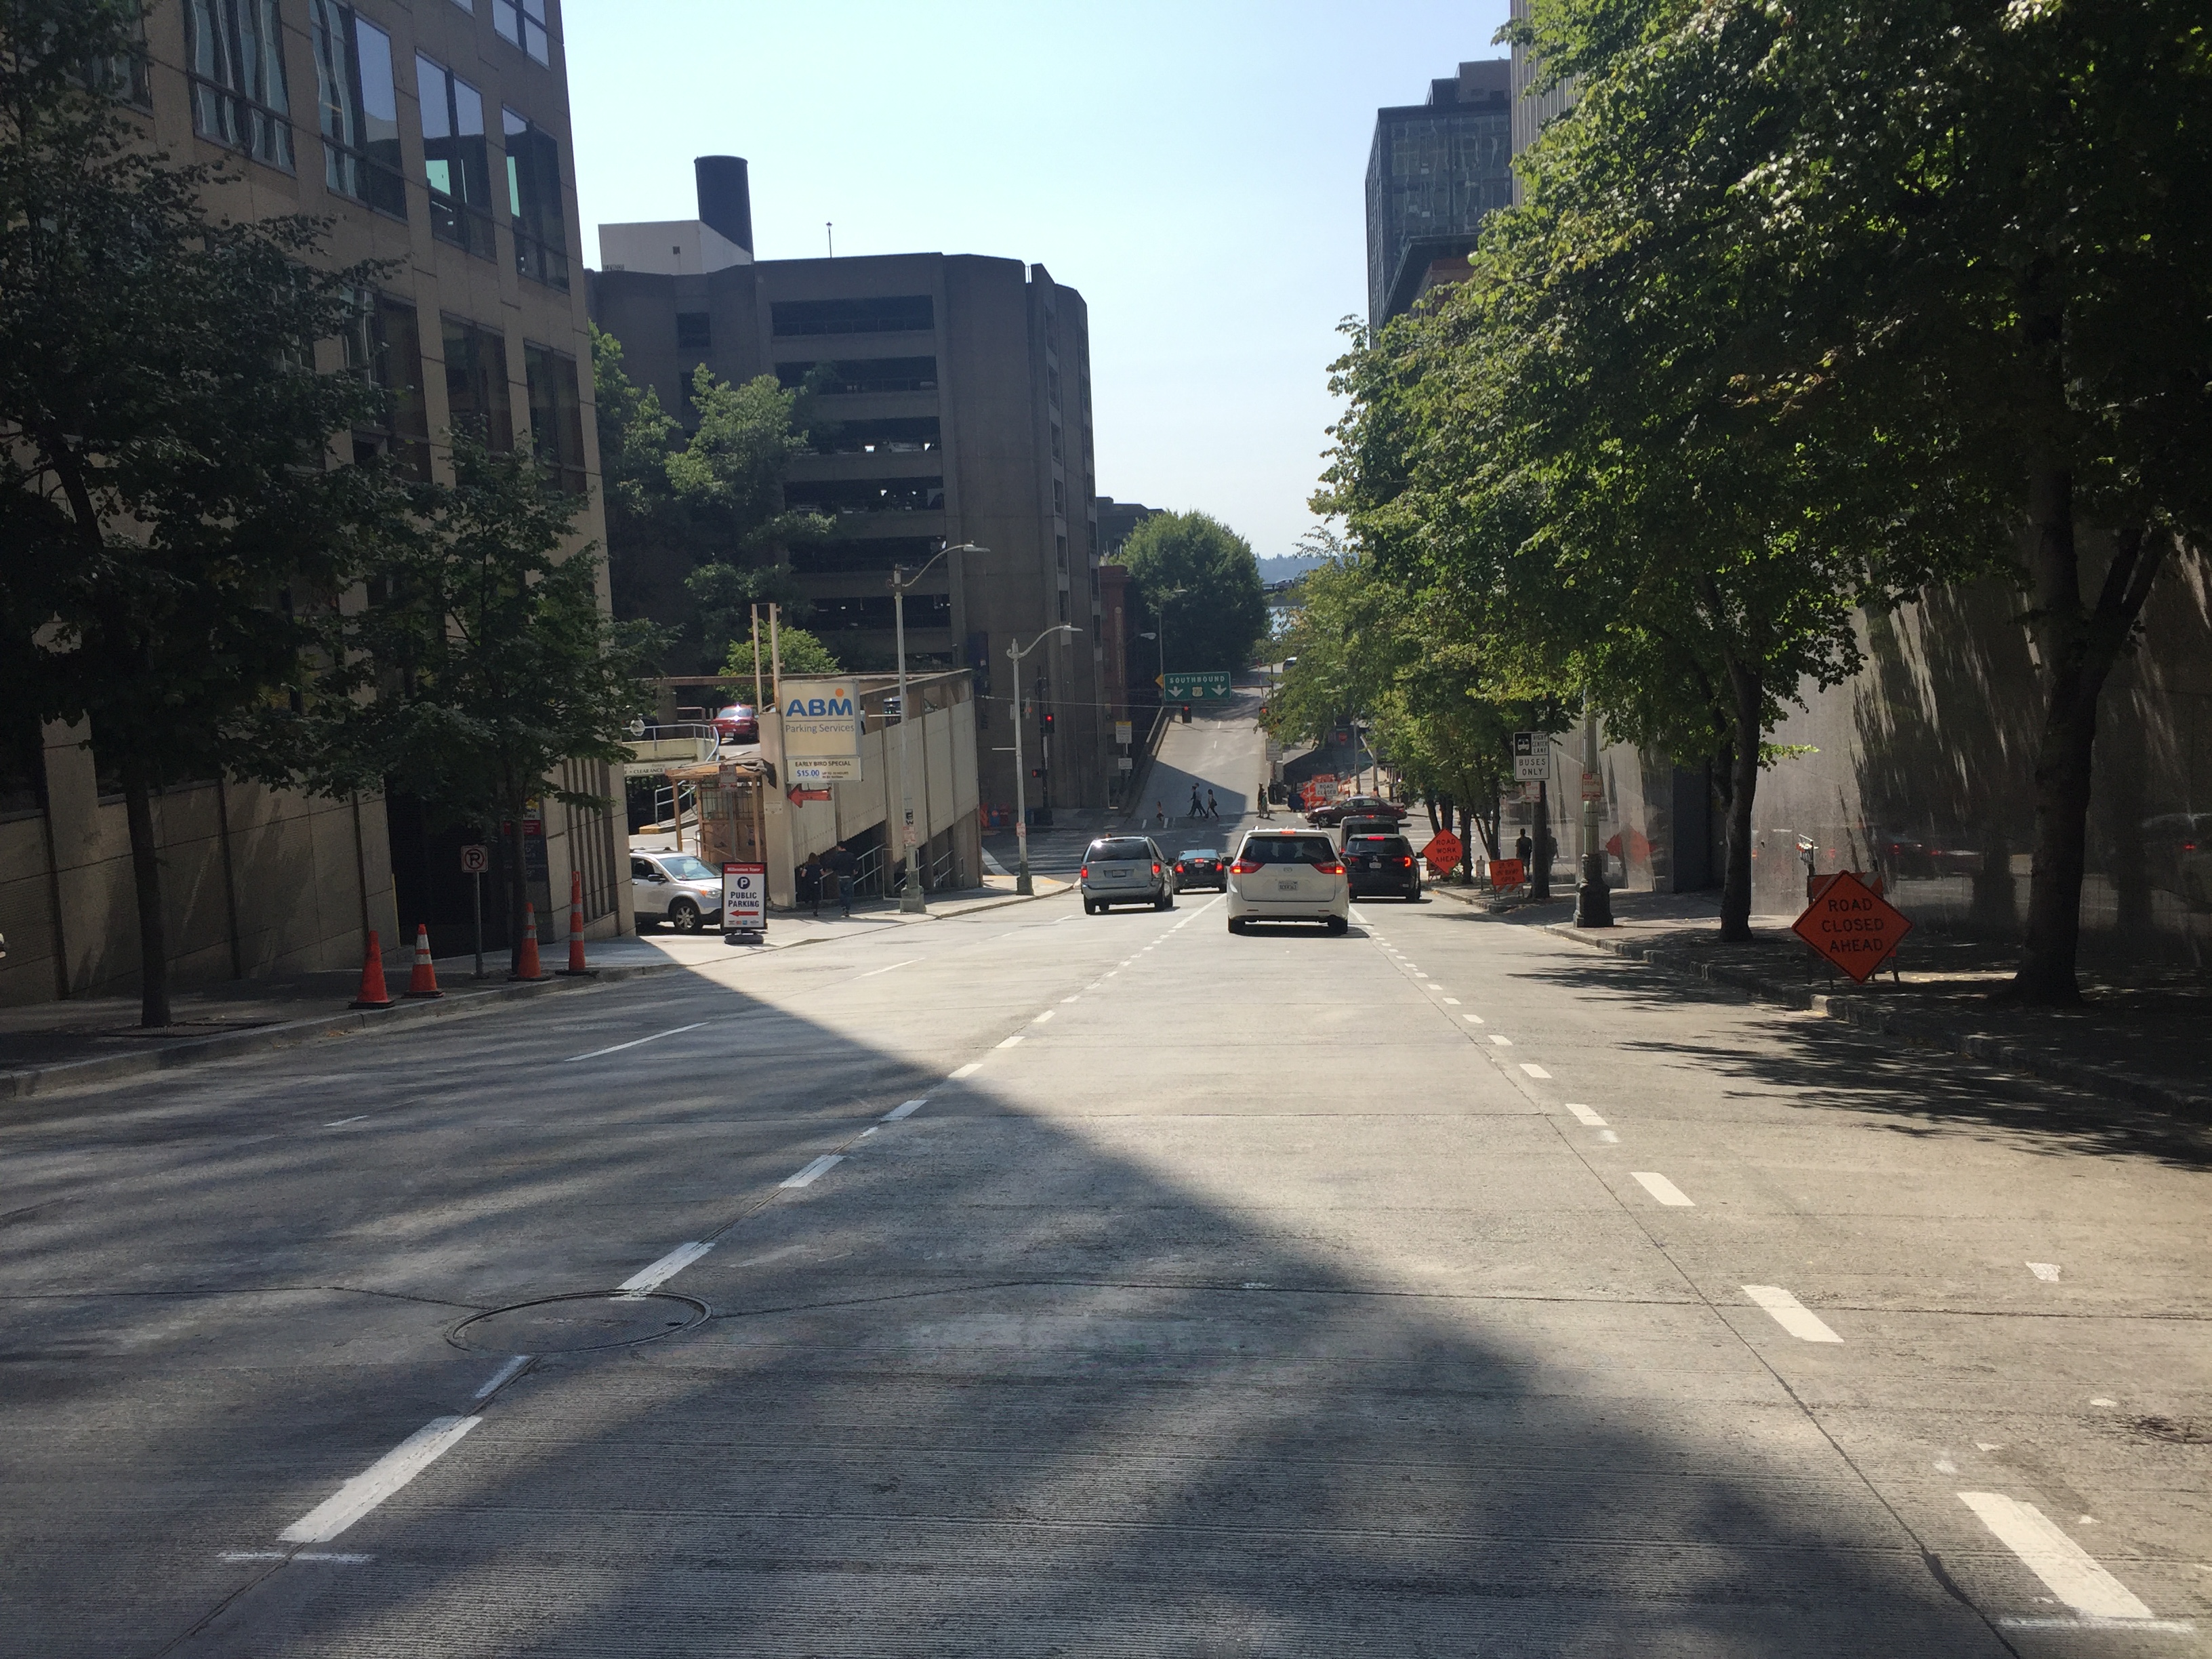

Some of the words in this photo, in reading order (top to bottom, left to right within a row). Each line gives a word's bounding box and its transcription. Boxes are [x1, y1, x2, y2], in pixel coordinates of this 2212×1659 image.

[786, 699, 853, 716] ABM
[786, 724, 817, 734] Parking
[819, 724, 855, 733] Services
[797, 769, 819, 777] $15.00
[1522, 768, 1543, 776] ONLY
[1828, 898, 1872, 912] ROAD
[1822, 918, 1884, 933] CLOSED
[1830, 938, 1883, 953] AHEAD
